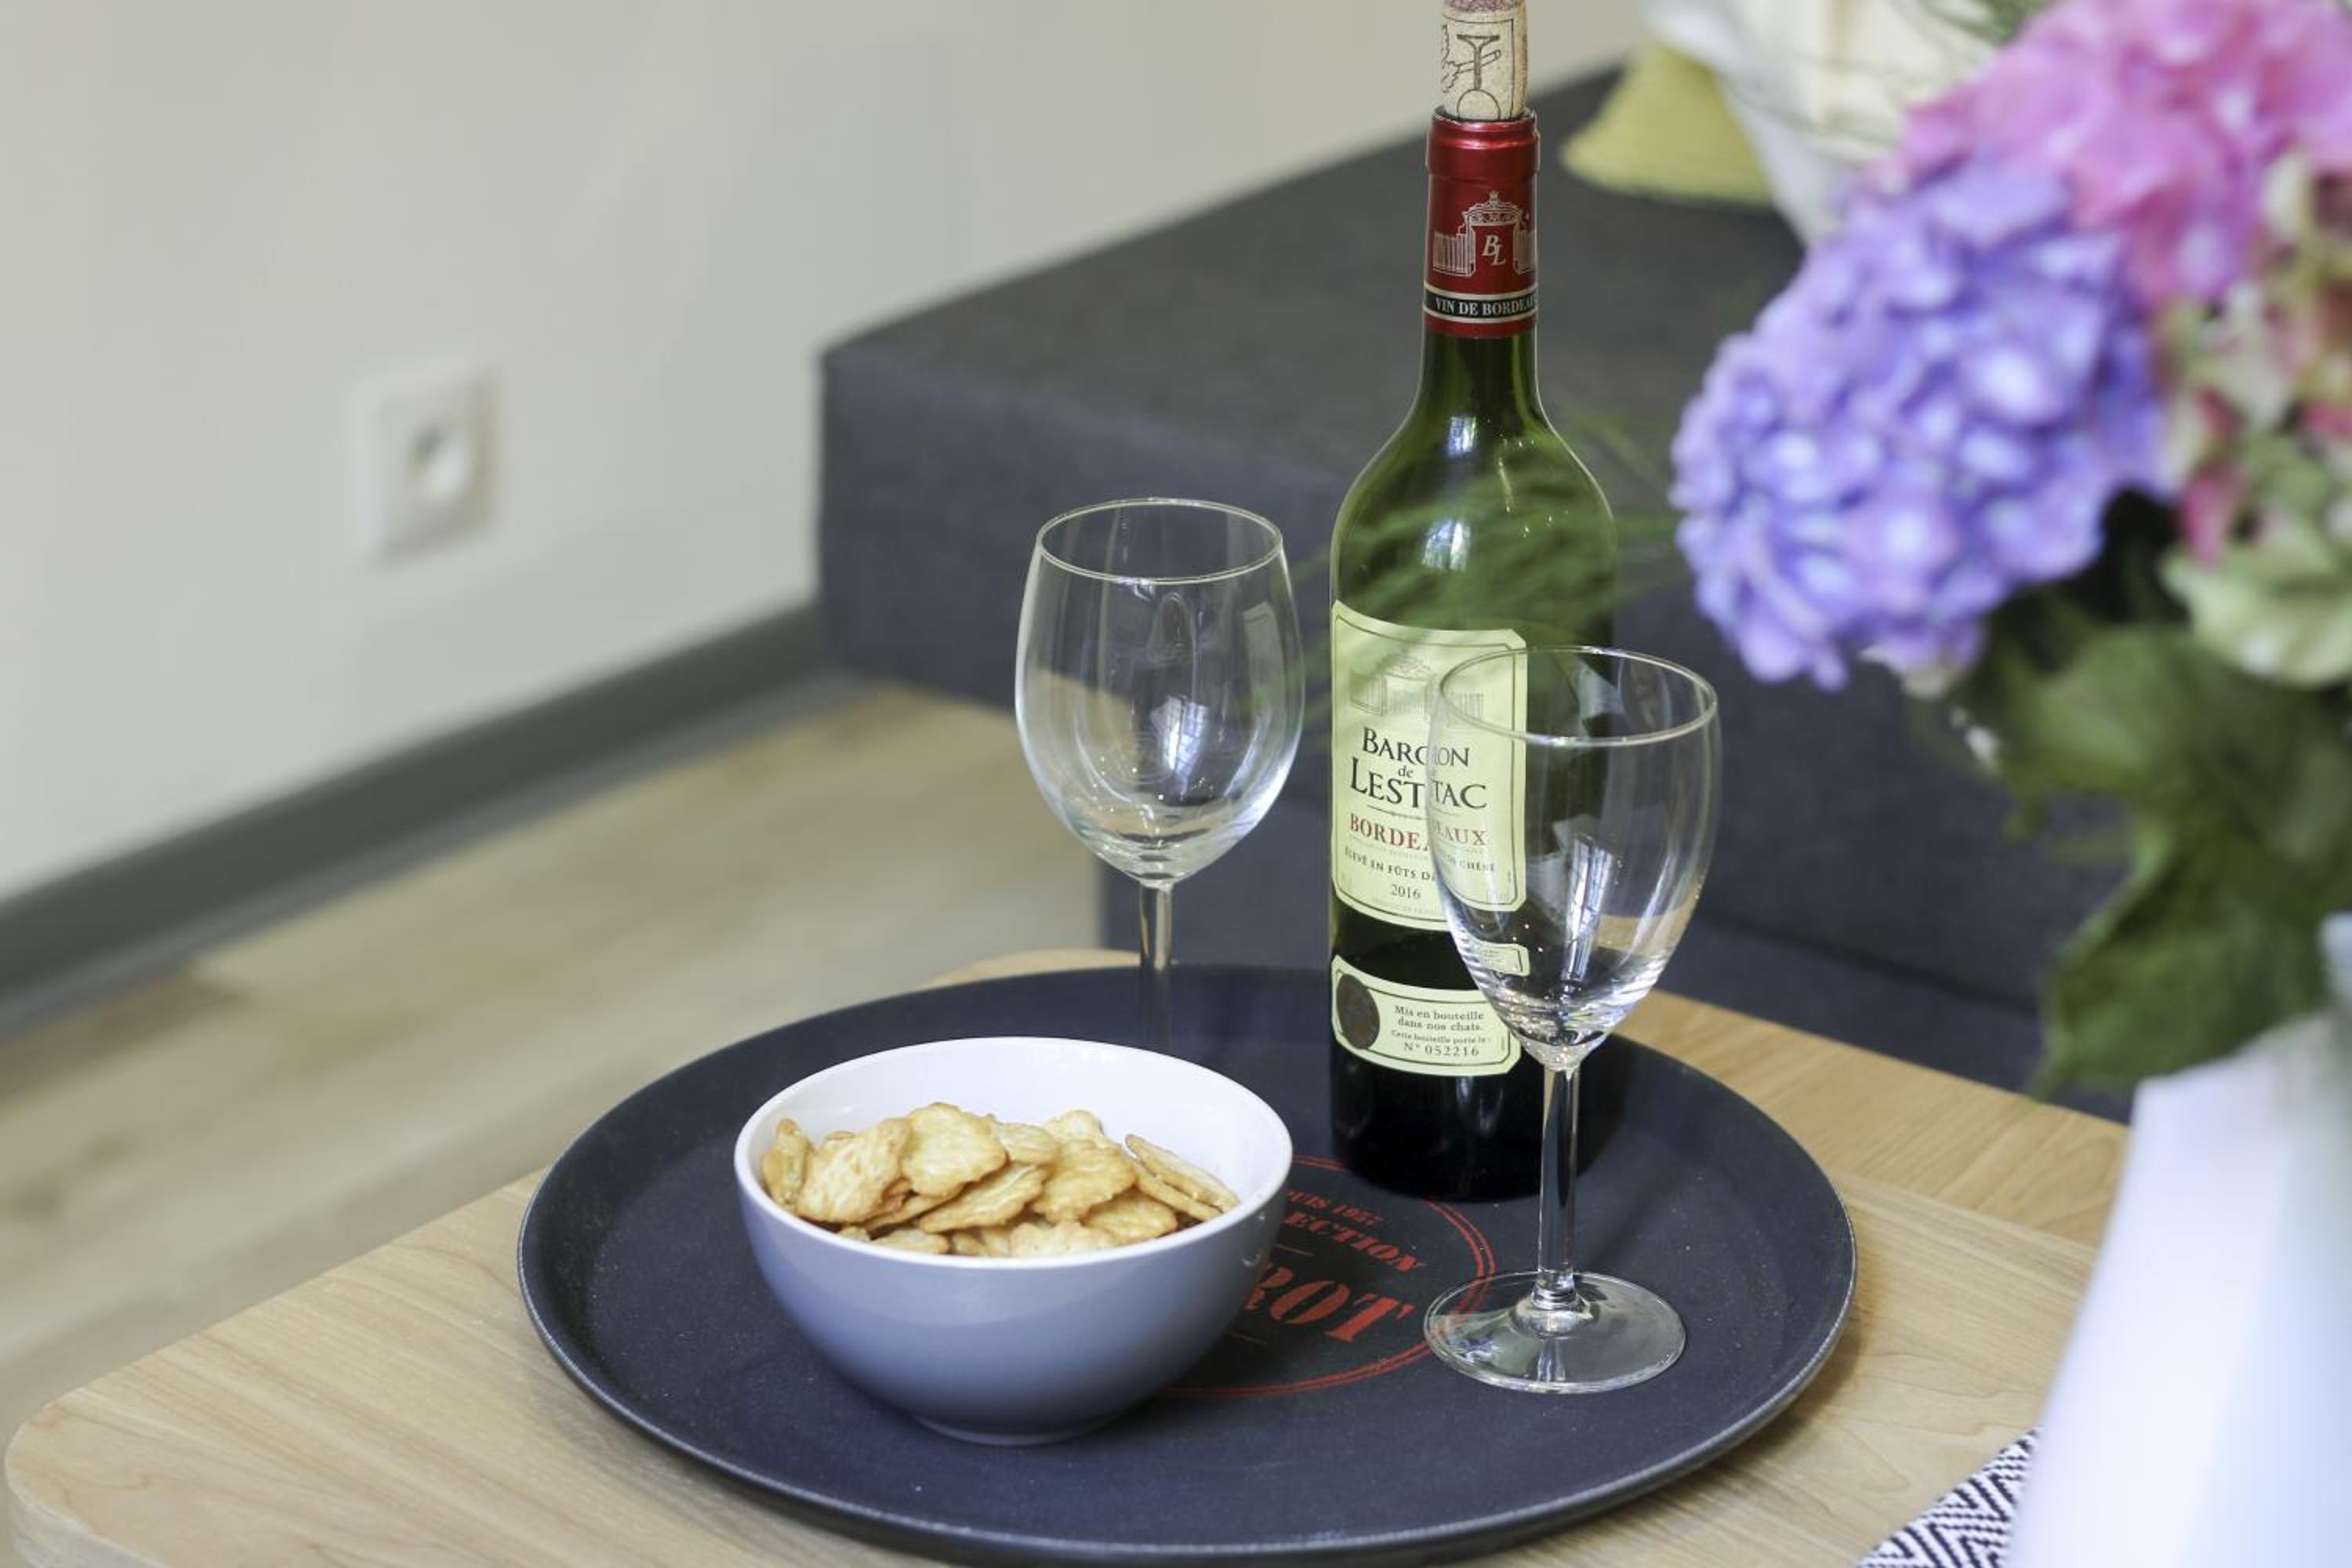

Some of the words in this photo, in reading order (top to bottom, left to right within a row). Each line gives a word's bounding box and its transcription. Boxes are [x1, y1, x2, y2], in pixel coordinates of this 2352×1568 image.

[1436, 297, 1456, 314] VIN
[1459, 301, 1479, 316] DE
[1398, 765, 1414, 779] de
[1391, 884, 1421, 899] 2016
[1395, 1004, 1414, 1016] Mis
[1433, 1010, 1484, 1021] bouteille
[1398, 1016, 1423, 1029] dans
[1427, 1022, 1446, 1031] nos
[1425, 1044, 1479, 1057] 052216
[1281, 1210, 1427, 1273] ECTION
